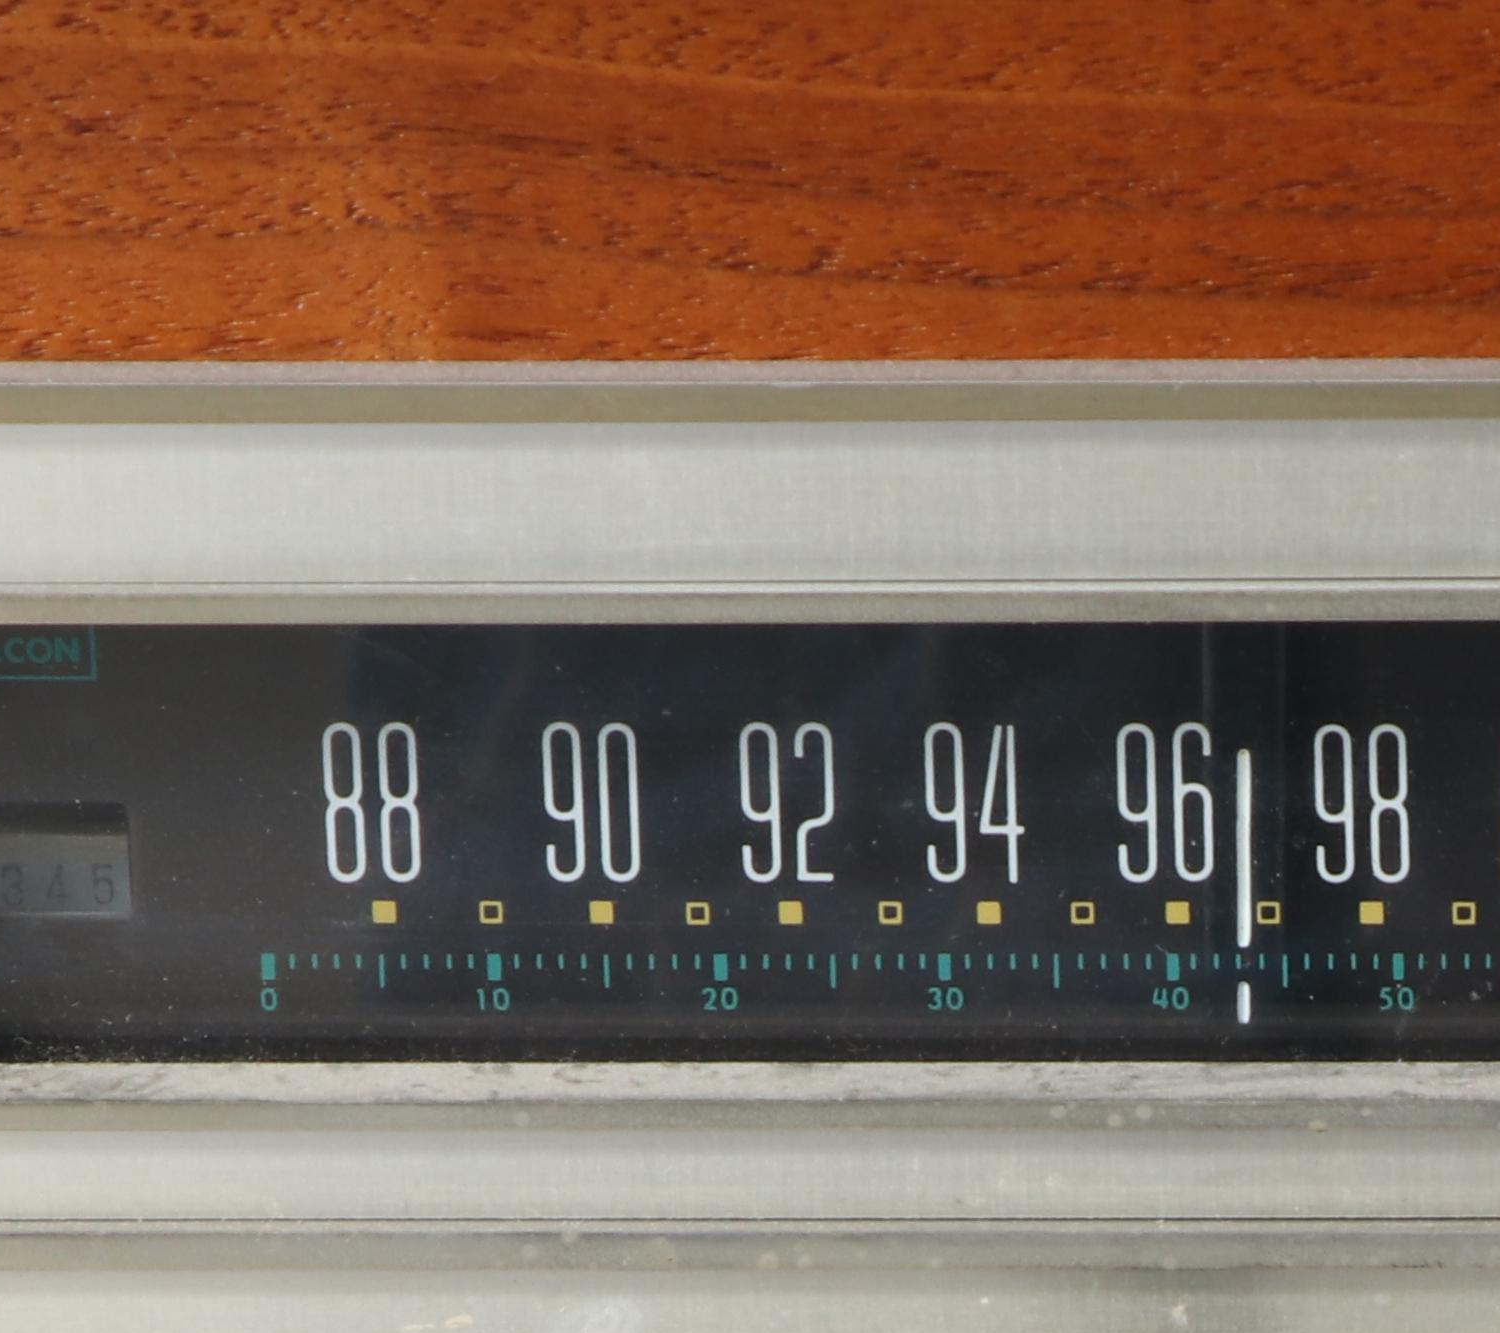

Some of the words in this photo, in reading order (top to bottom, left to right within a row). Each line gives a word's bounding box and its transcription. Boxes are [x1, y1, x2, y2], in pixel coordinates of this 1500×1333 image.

[322, 722, 422, 884] 88
[542, 722, 641, 883] 90
[739, 722, 835, 883] 92
[924, 722, 1025, 884] 94
[1116, 722, 1214, 883] 96
[1314, 724, 1410, 884] 98
[260, 987, 278, 1011] 0
[476, 987, 510, 1011] 10
[702, 986, 738, 1011] 20
[927, 987, 964, 1011] 30
[1152, 986, 1189, 1010] 40
[1379, 983, 1415, 1012] 50
